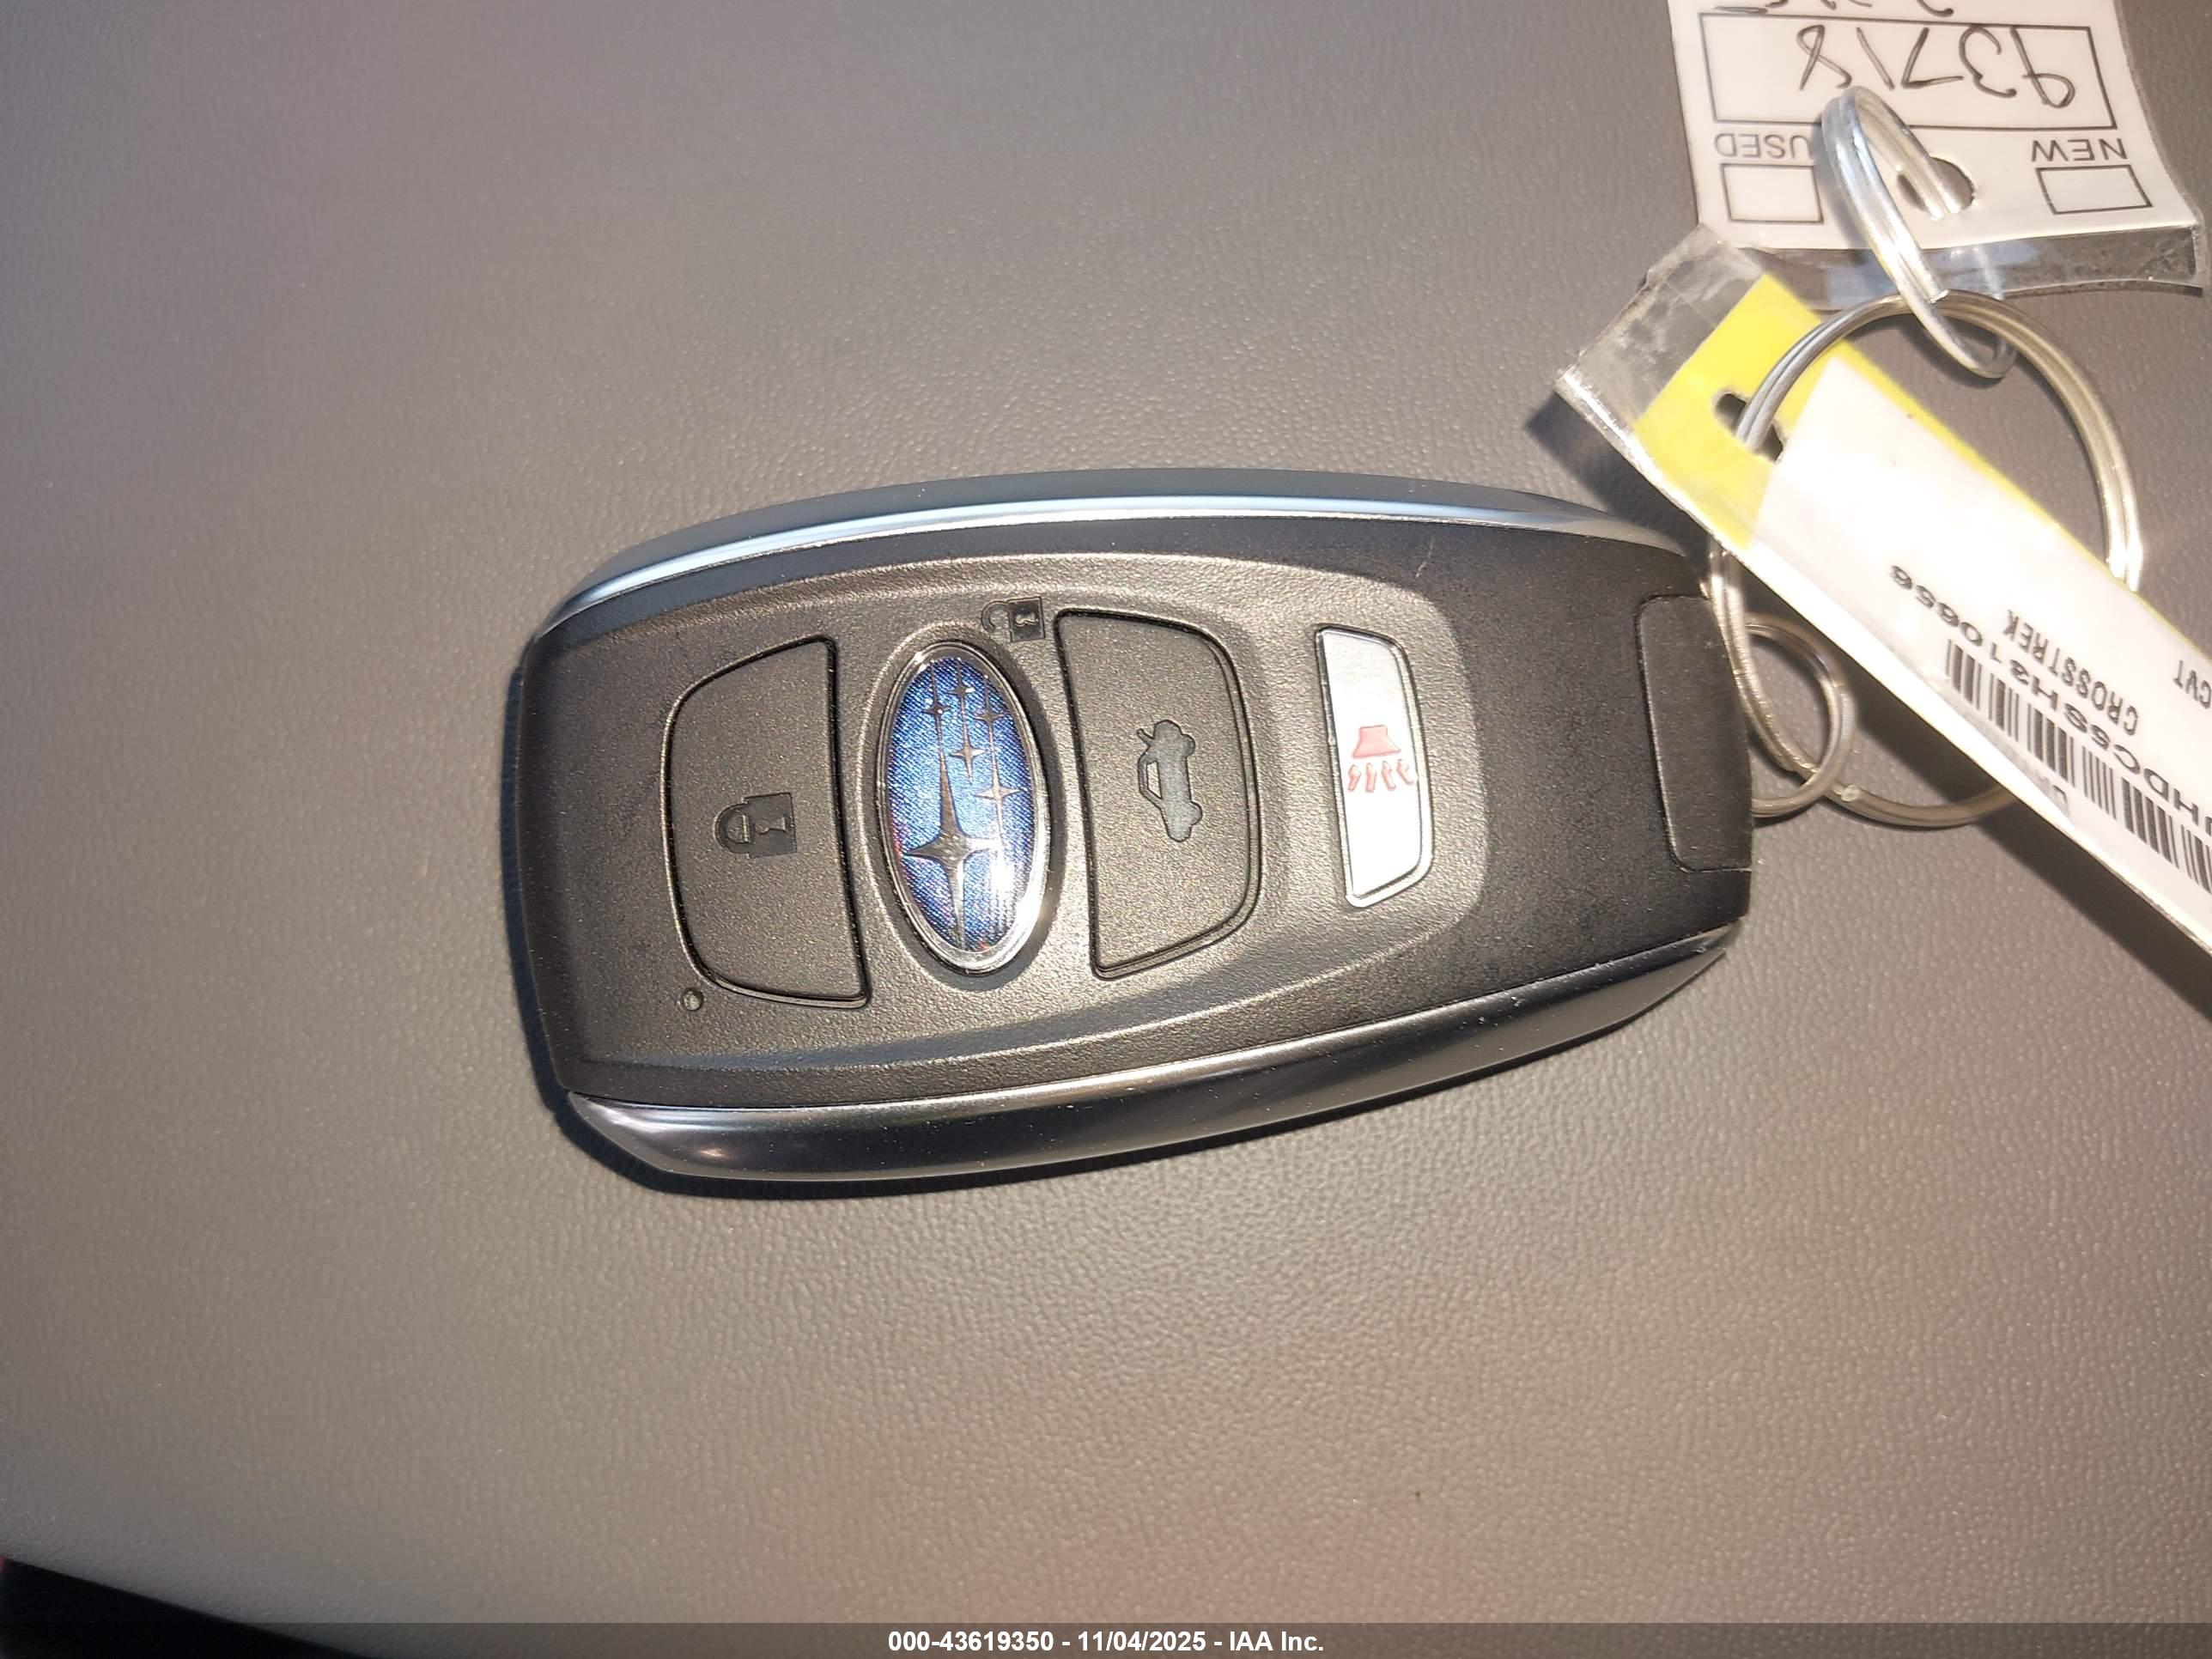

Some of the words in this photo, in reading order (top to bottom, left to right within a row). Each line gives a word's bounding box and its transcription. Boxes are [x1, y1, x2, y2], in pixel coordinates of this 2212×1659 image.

[1796, 24, 2075, 109] 93718
[1714, 132, 1814, 160] USED
[2032, 137, 2127, 162] NEW
[2002, 609, 2139, 736] CROSSTREK
[2172, 659, 2212, 709] CVT
